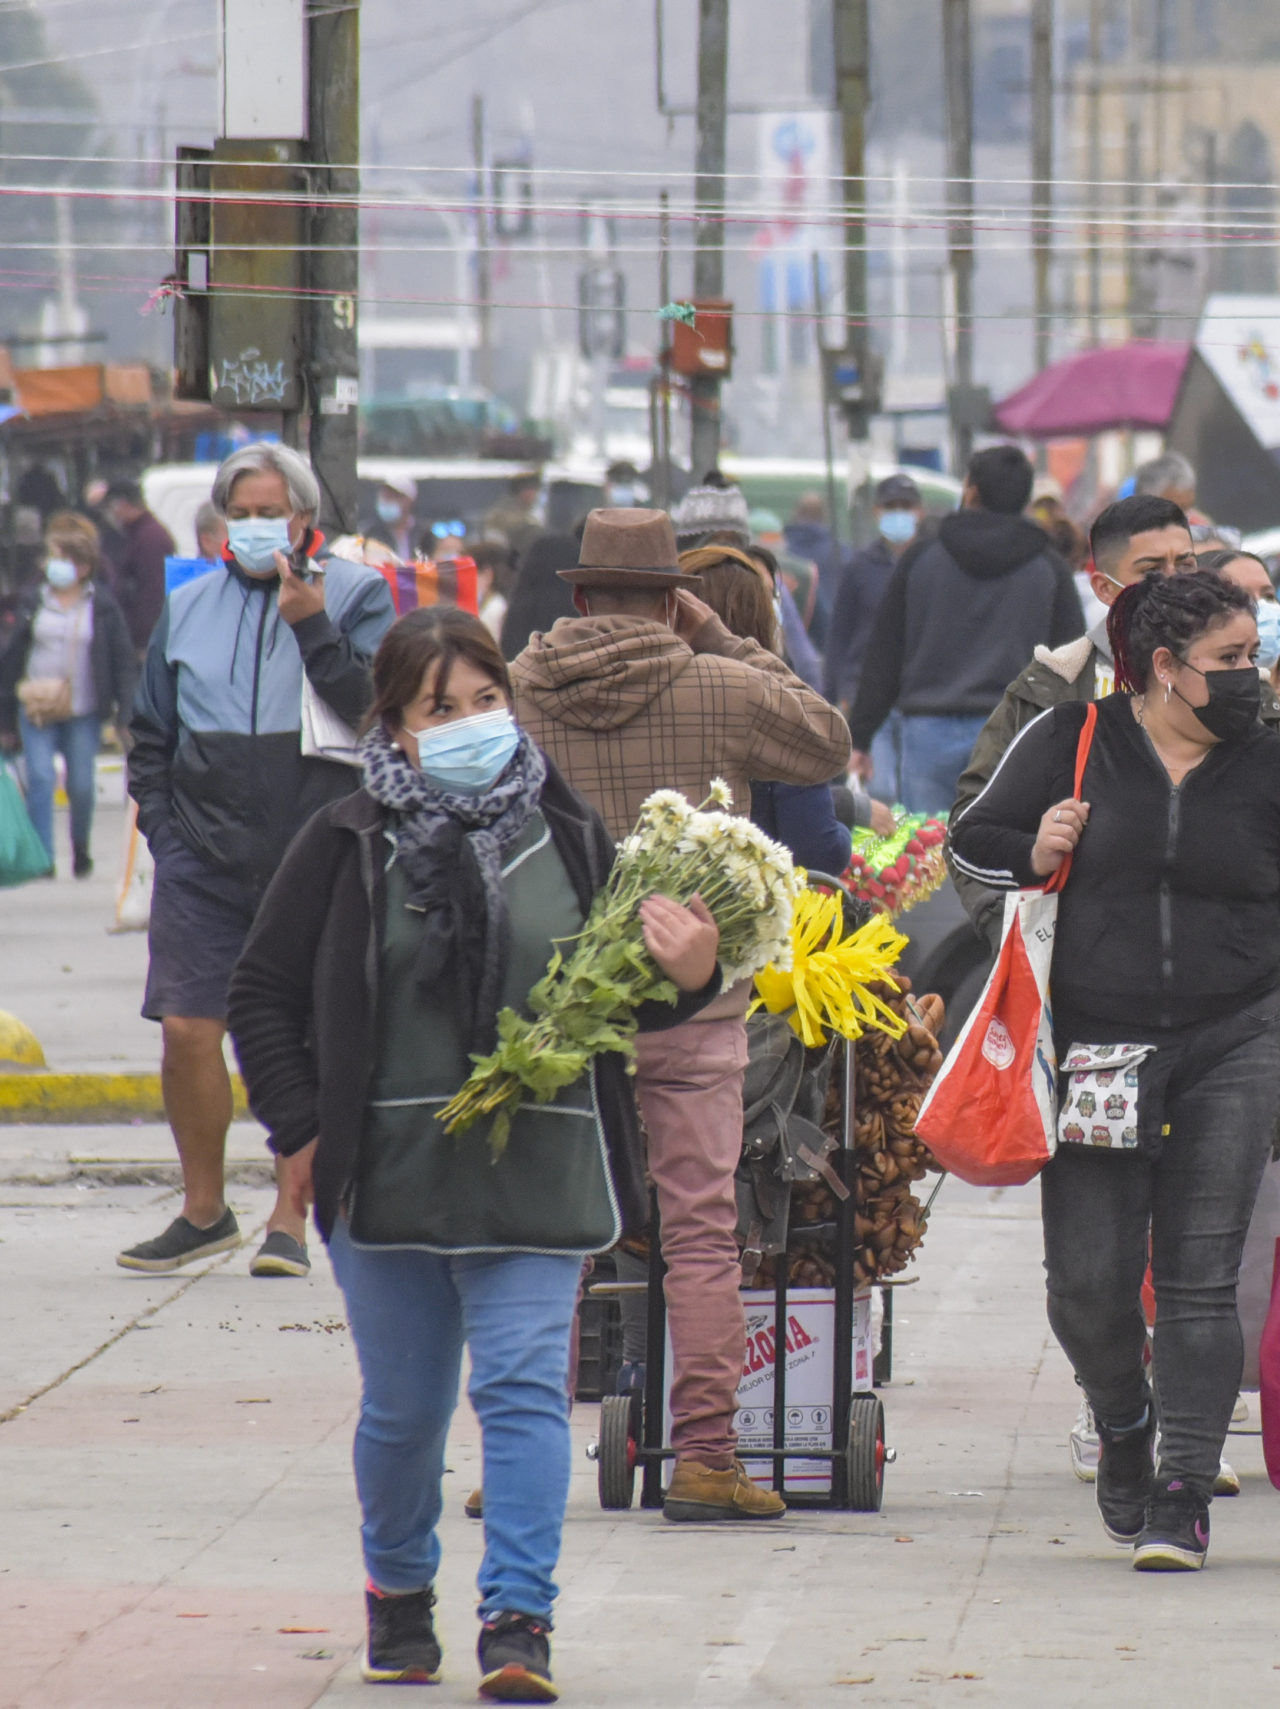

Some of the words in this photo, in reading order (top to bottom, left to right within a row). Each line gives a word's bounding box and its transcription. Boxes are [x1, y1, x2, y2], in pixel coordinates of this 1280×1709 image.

[1035, 927, 1053, 942] EL
[742, 1315, 812, 1377] ZOA
[737, 1376, 765, 1395] MEJOR
